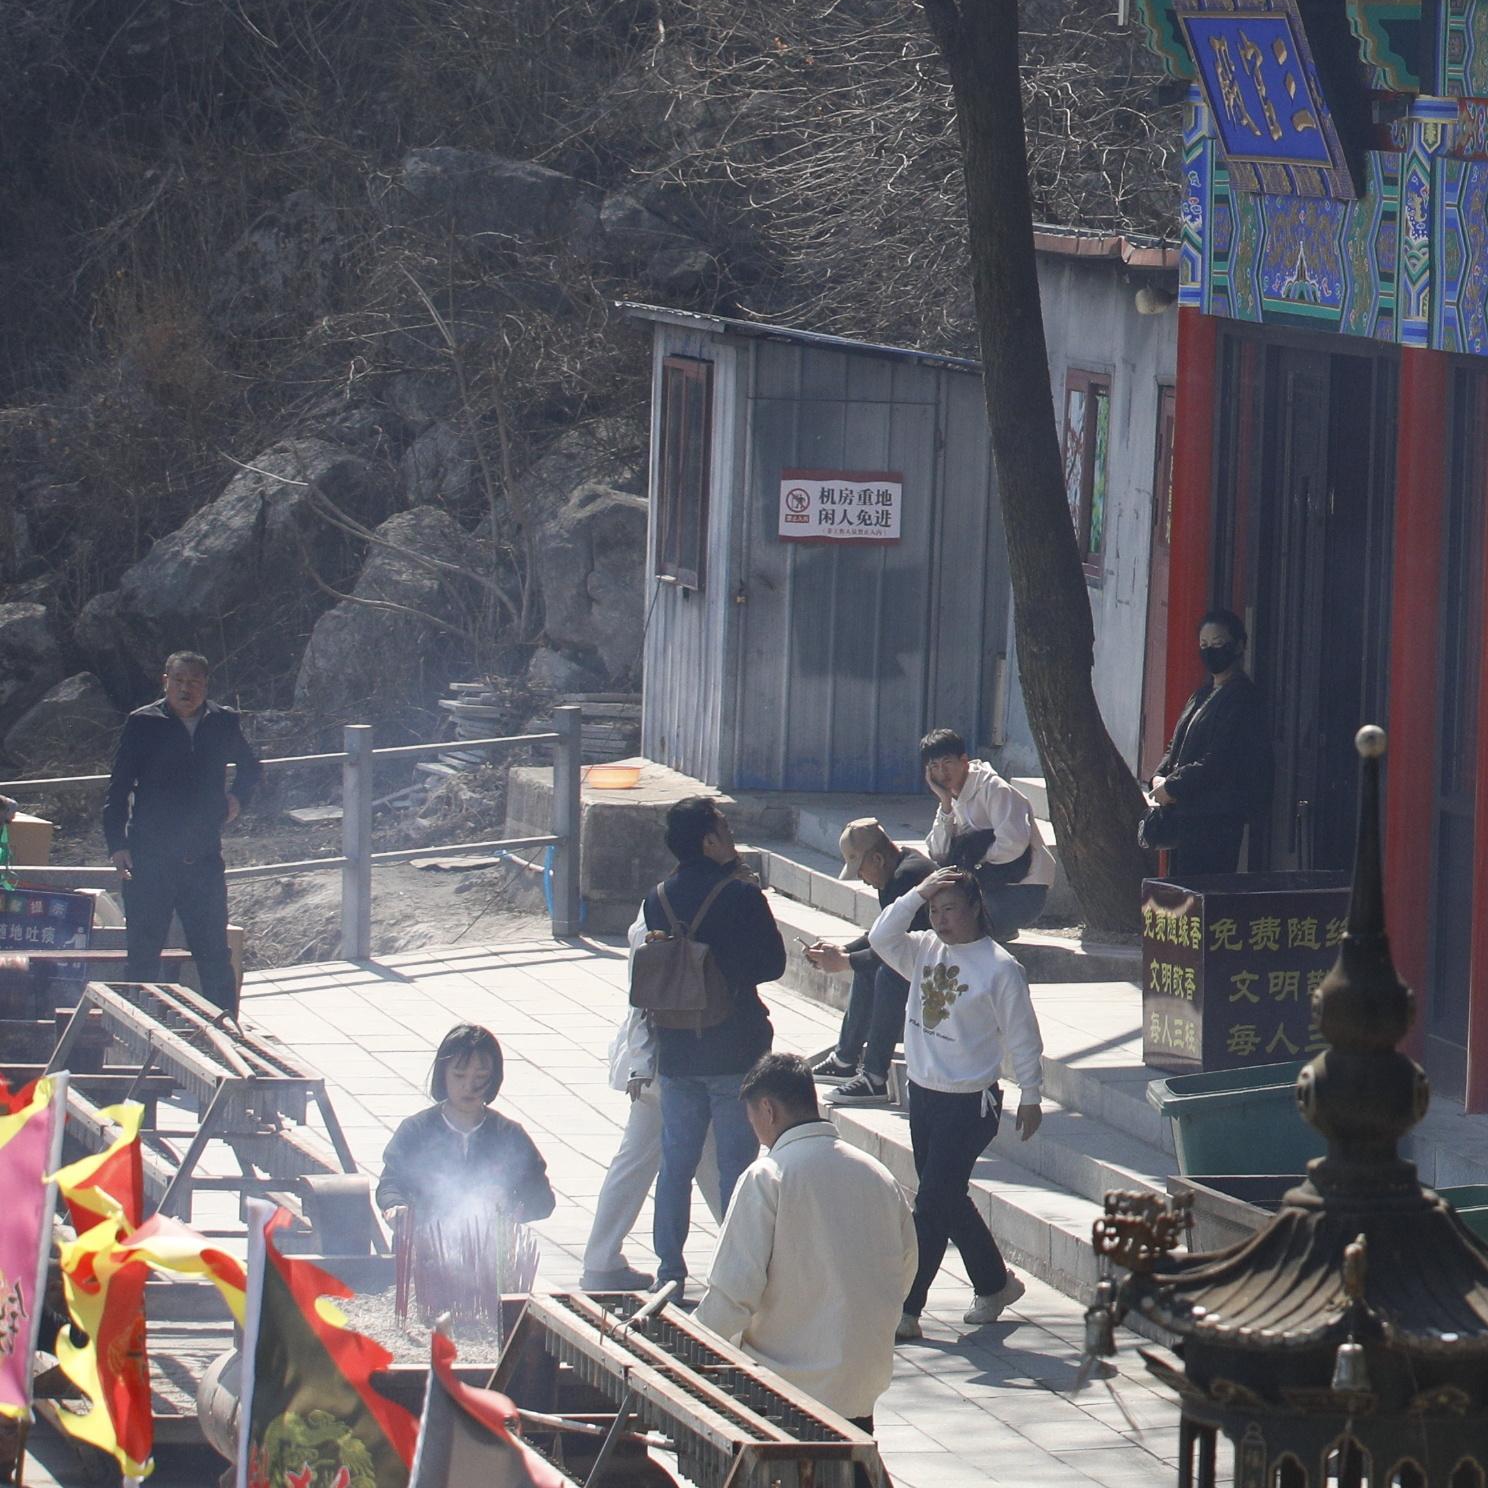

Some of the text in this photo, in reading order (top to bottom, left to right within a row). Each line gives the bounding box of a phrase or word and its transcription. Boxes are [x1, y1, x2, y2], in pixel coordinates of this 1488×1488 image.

[1208, 28, 1318, 142] 三官殿
[818, 508, 892, 528] 闲人免进
[819, 487, 893, 507] 机房重地
[1143, 904, 1202, 950] 免费随缘香
[1149, 957, 1197, 1001] 文明敬香
